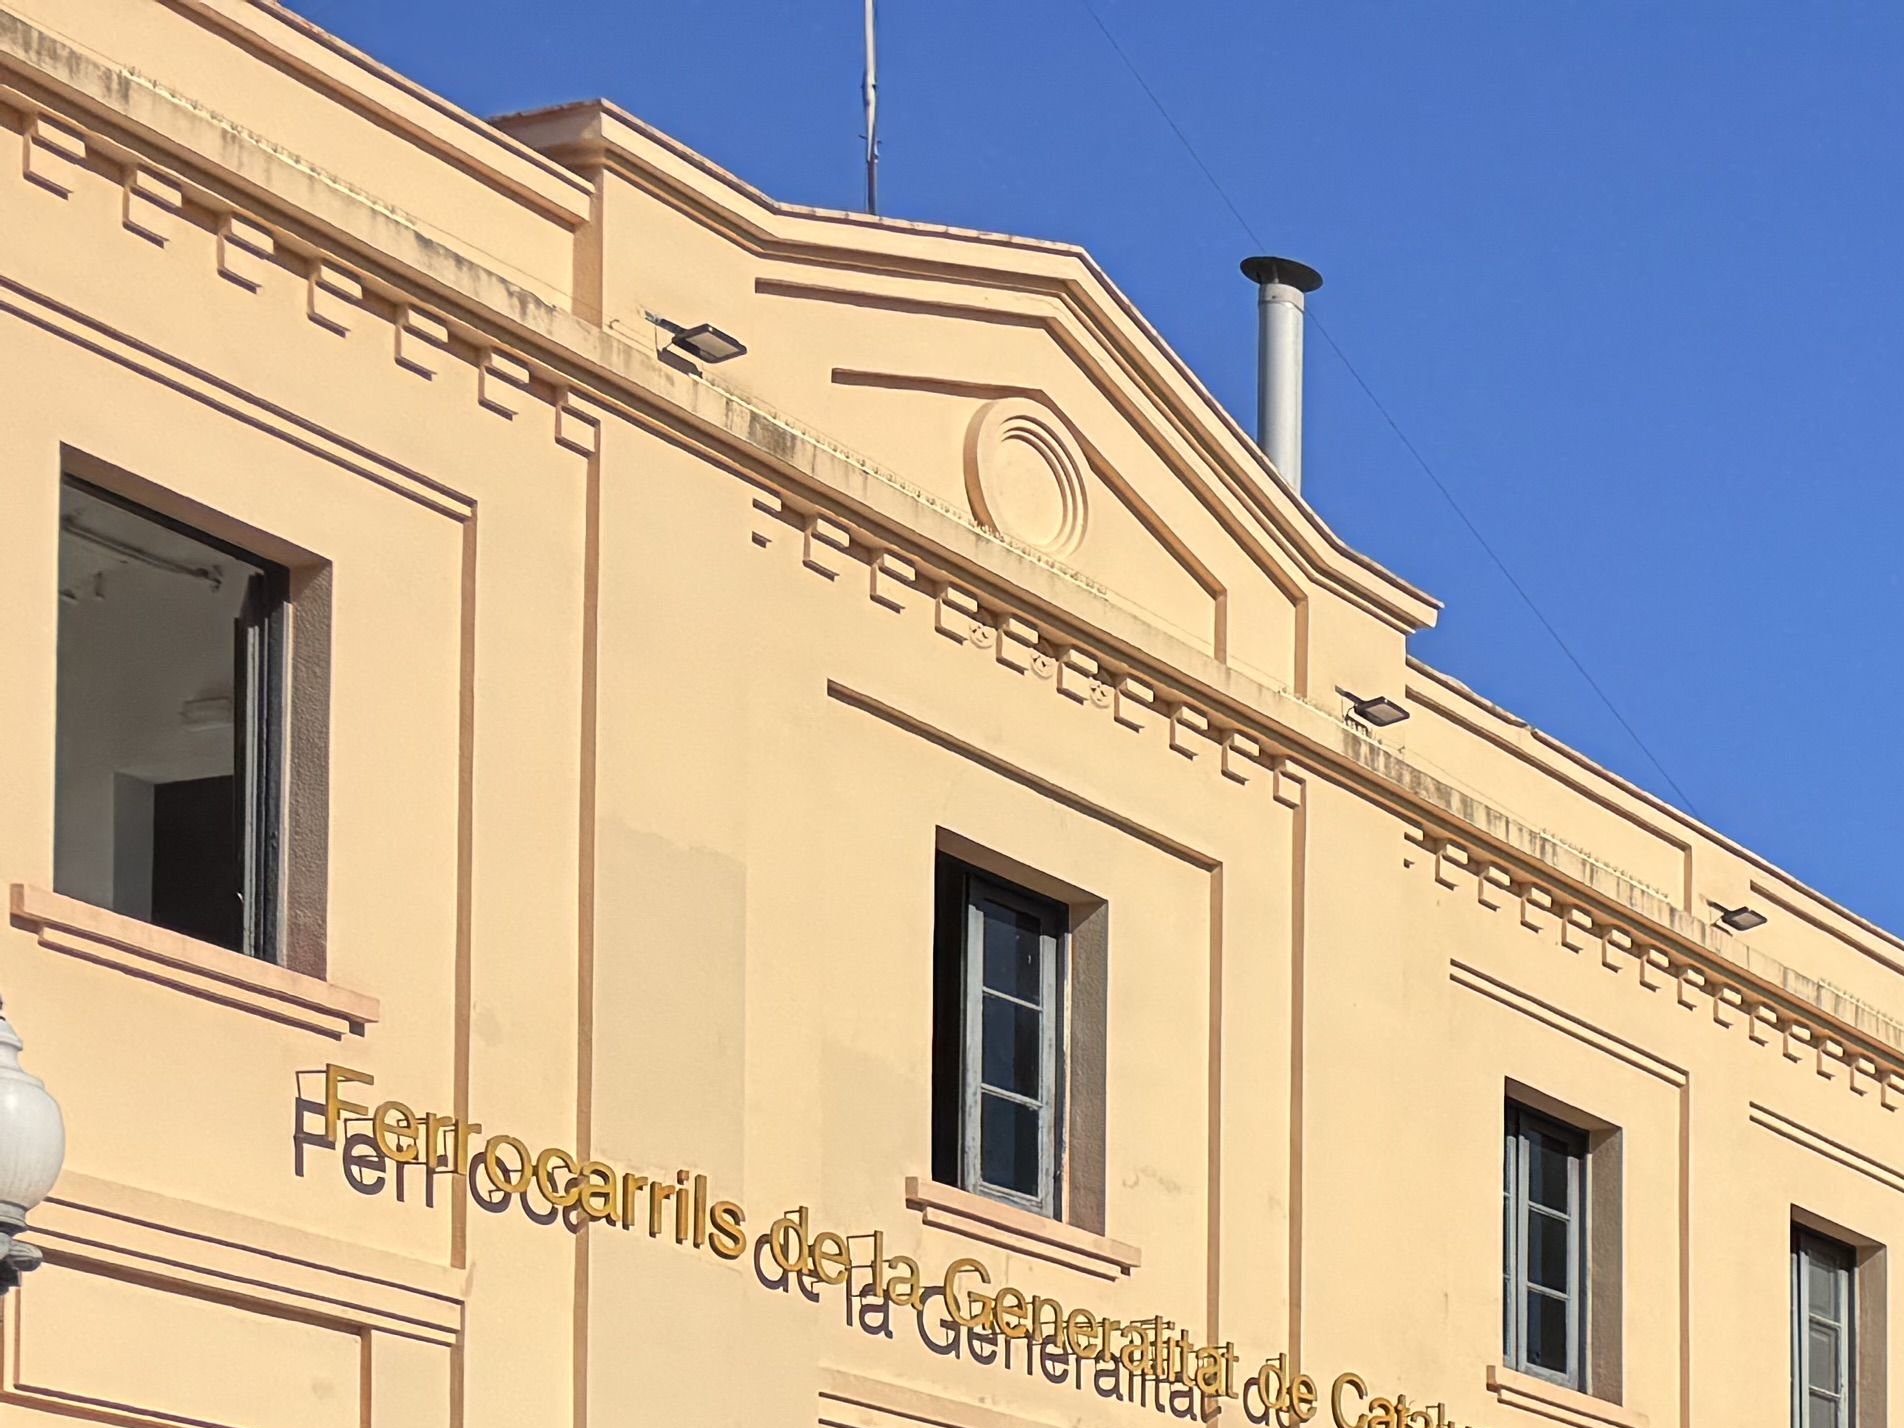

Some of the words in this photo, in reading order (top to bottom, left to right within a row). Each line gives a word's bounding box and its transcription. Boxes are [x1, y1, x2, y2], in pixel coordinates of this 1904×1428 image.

[325, 1063, 748, 1261] Ferrocarrils
[769, 1205, 851, 1286] de
[872, 1230, 923, 1312] la
[942, 1256, 1240, 1400] Generalitat
[1257, 1352, 1319, 1424] de
